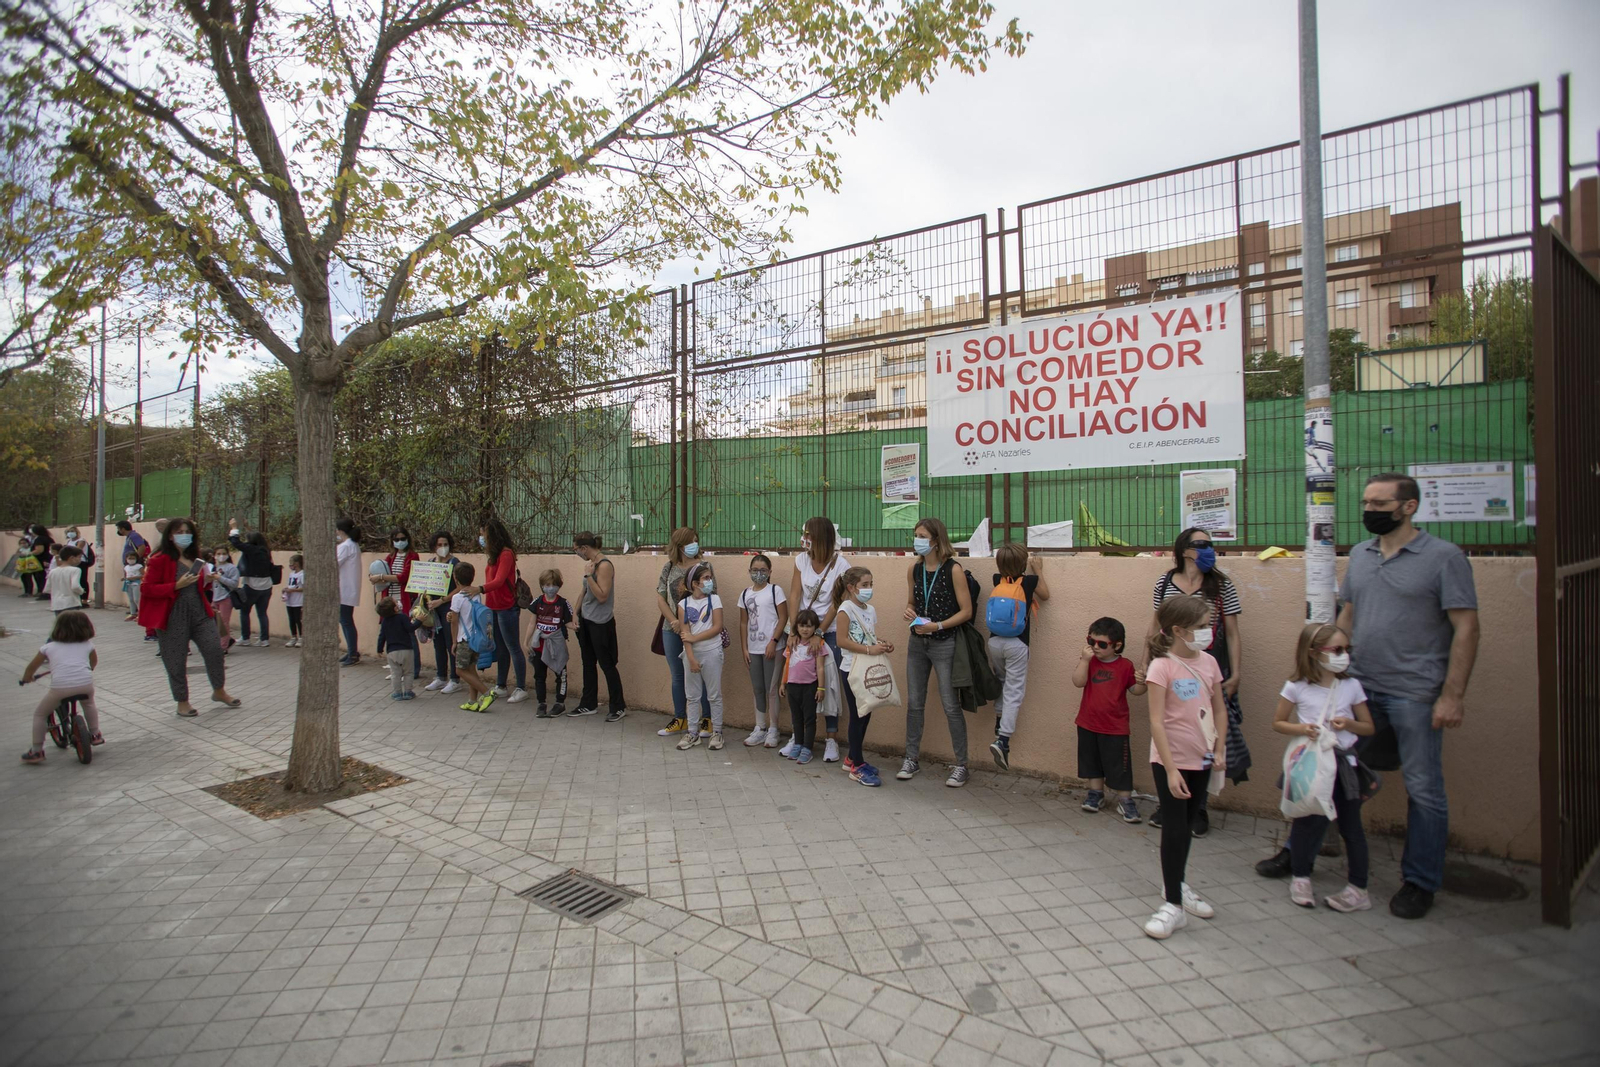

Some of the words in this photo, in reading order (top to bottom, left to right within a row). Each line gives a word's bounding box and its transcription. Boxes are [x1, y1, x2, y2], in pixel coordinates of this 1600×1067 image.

[962, 312, 1140, 364] SOLUCIÓN
[1151, 301, 1228, 338] YA!!
[956, 364, 1006, 393] SIN
[1016, 339, 1204, 386] COMEDOR
[1009, 386, 1057, 415] NO
[1068, 376, 1140, 409] HAY
[954, 396, 1207, 447] CONCILIACIÓN
[1128, 441, 1154, 449] C.E.I.P.
[1155, 436, 1220, 447] ABENCERRAJES
[982, 450, 996, 458] AFA
[998, 448, 1031, 457] Nazaríes
[1186, 487, 1229, 500] #COMEDORYA
[1201, 497, 1224, 506] COMEDOR
[1097, 669, 1113, 679] NIKE
